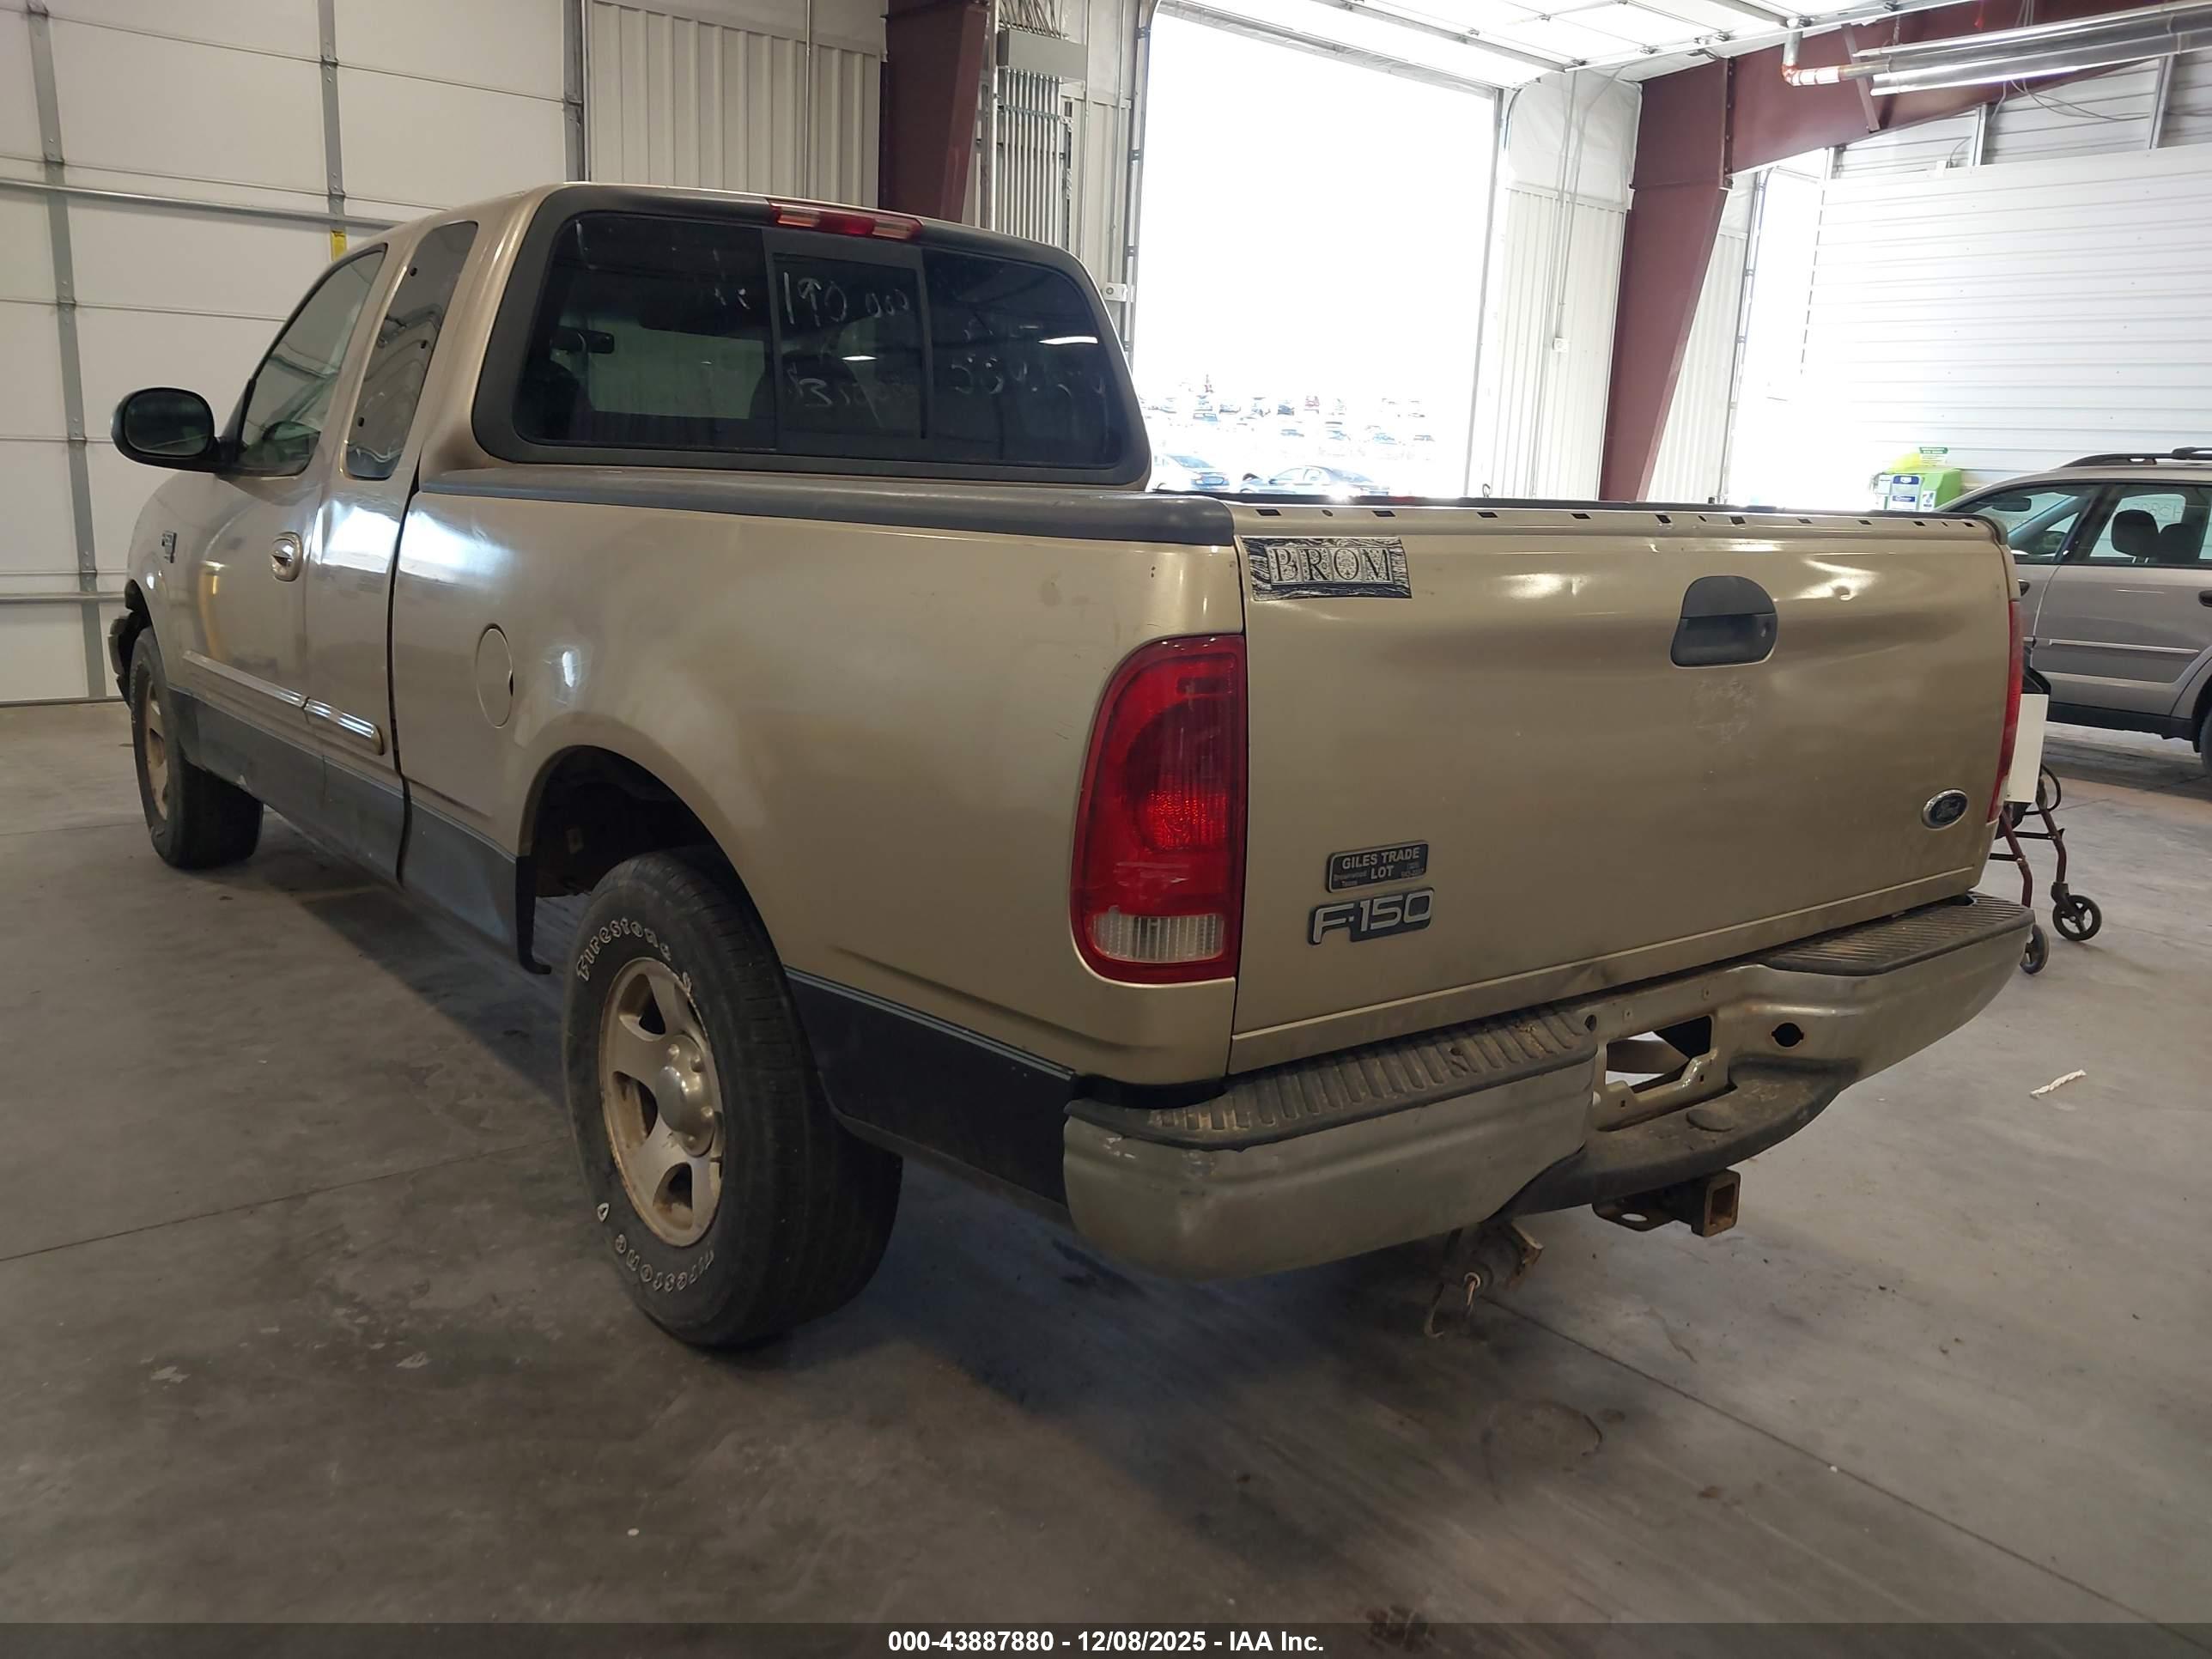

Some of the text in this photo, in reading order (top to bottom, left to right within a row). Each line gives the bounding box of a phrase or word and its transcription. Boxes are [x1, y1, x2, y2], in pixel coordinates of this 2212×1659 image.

[1342, 848, 1419, 869] GILES TRADE
[1370, 865, 1395, 880] LOT
